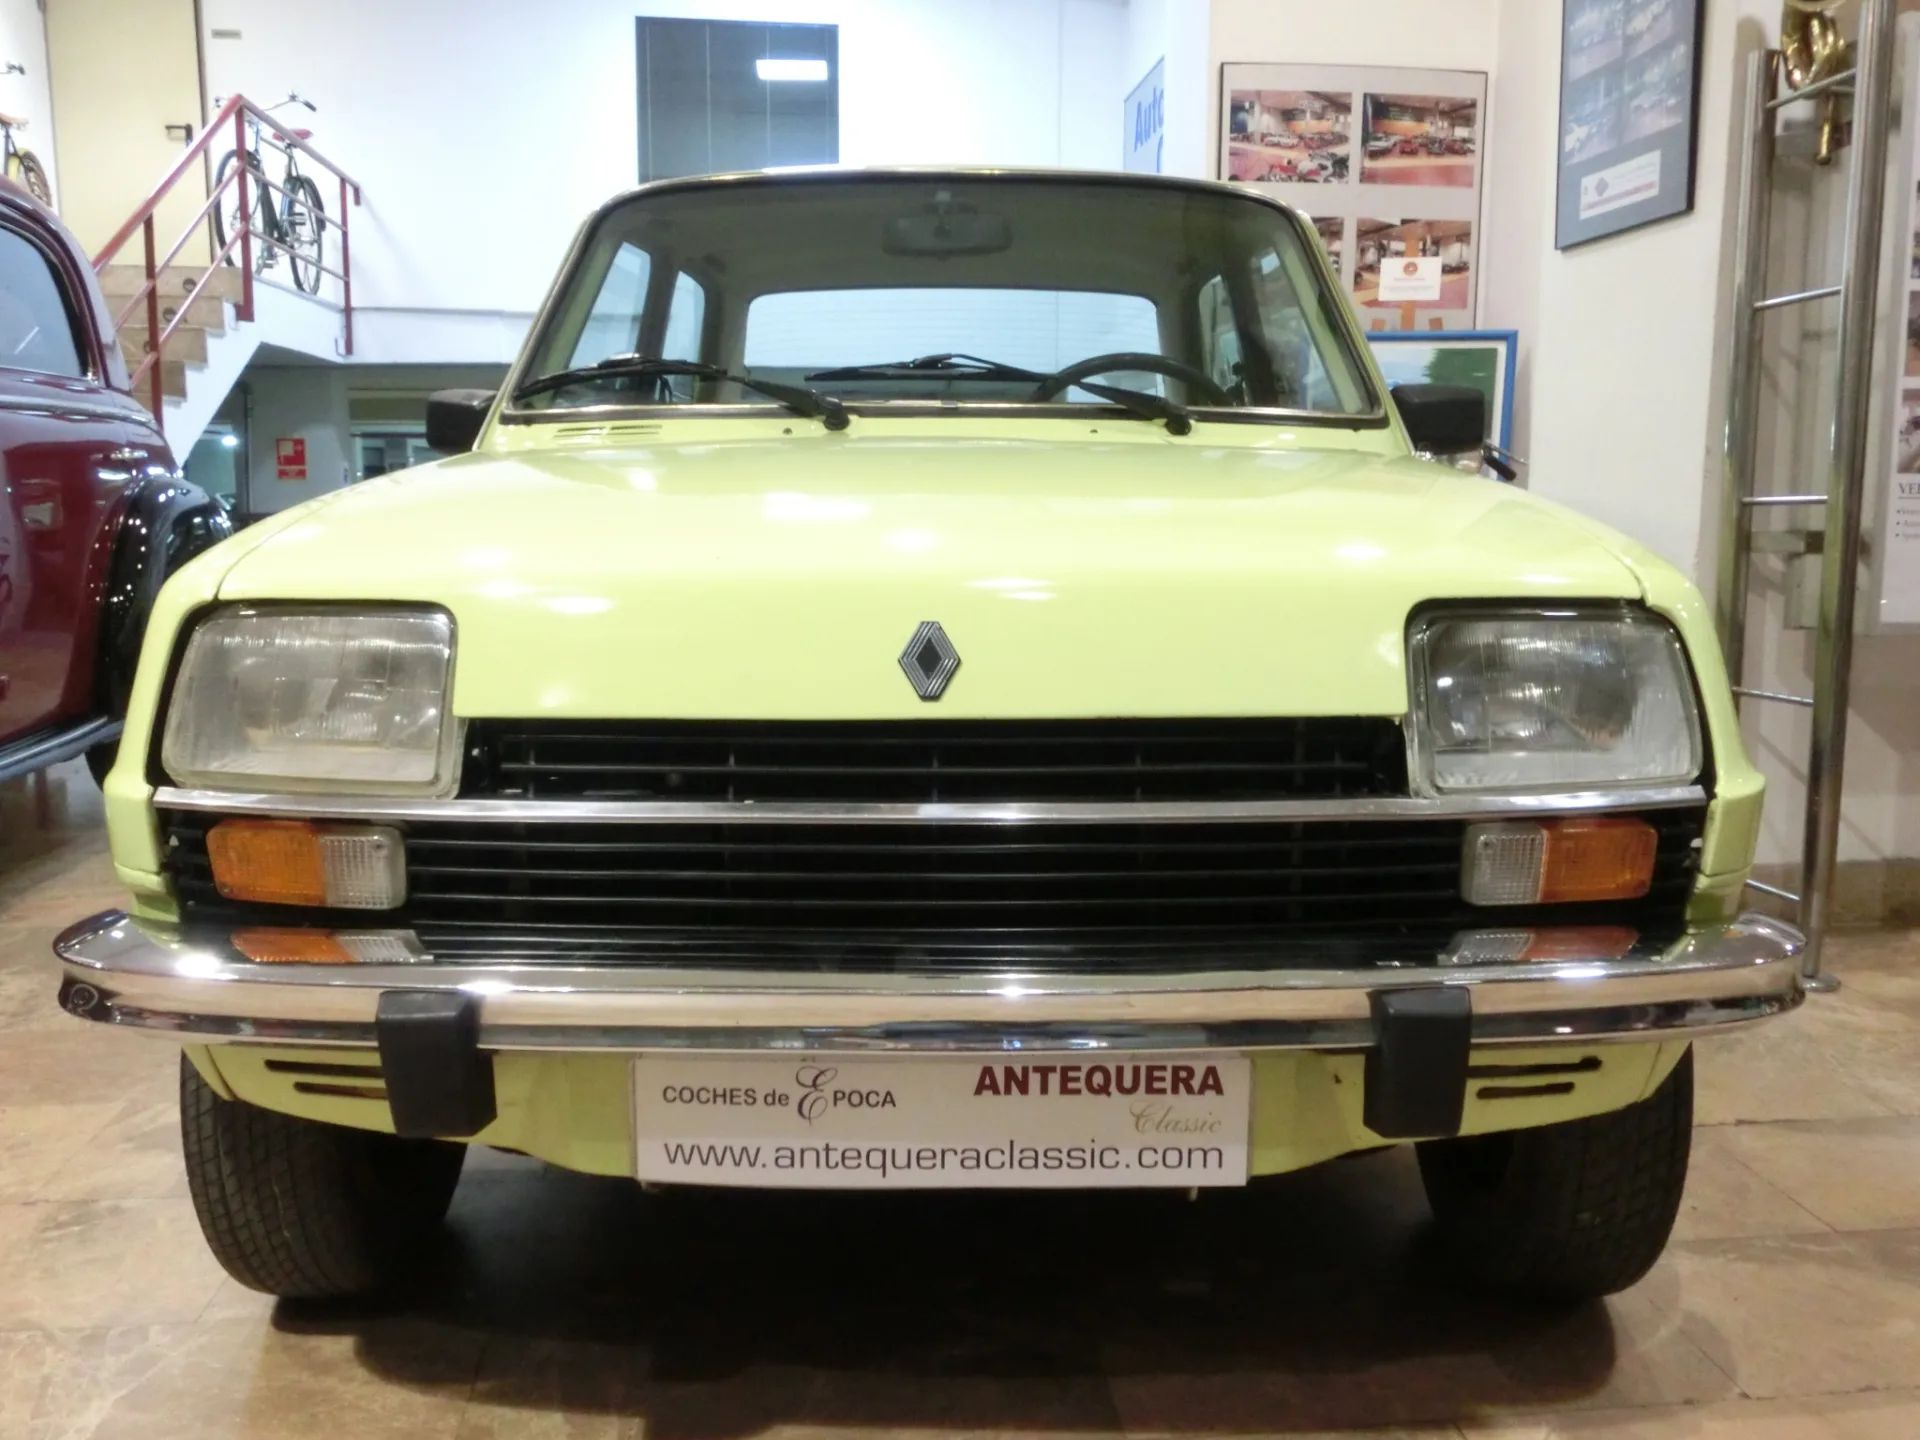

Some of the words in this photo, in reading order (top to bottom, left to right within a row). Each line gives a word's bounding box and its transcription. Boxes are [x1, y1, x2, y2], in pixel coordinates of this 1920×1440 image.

[662, 1085, 758, 1106] COCHES
[763, 1089, 790, 1107] de
[973, 1064, 1225, 1098] ANTEQUERA
[1129, 1100, 1223, 1135] Classic
[663, 1137, 1224, 1179] www.antequeraclassic.com
